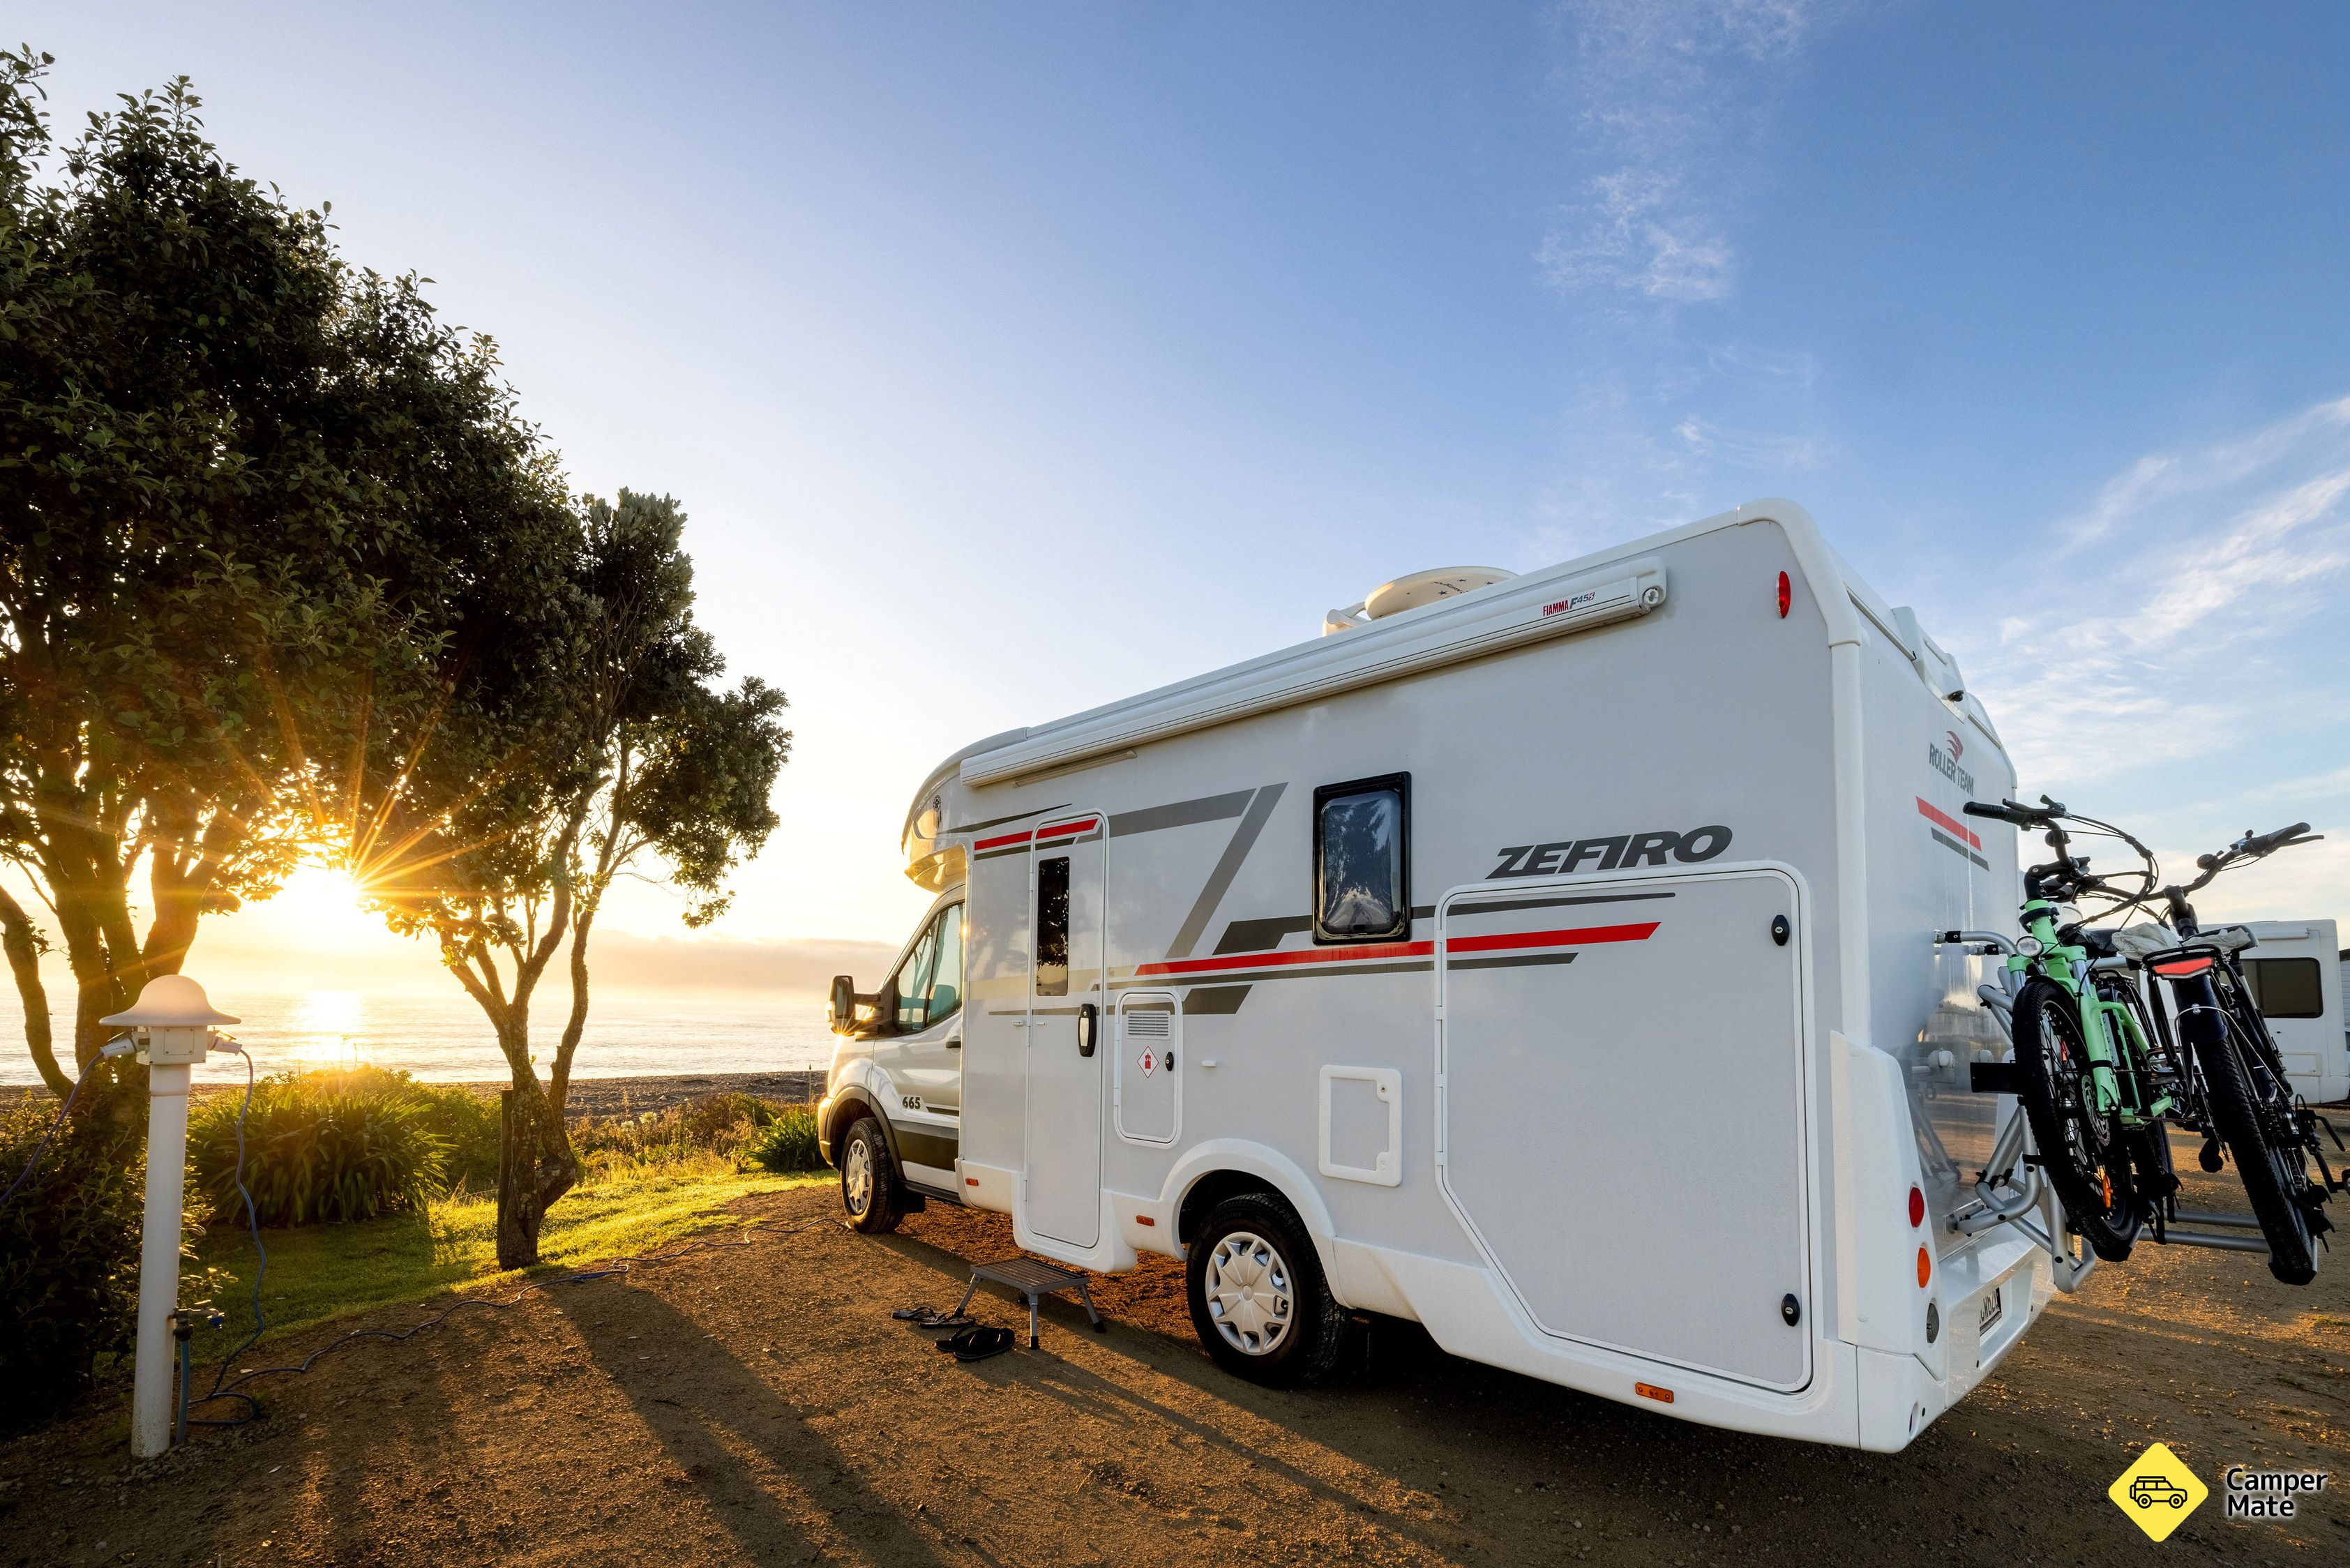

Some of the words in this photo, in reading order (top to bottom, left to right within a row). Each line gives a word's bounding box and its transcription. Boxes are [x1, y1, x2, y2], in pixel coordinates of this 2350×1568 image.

[1543, 600, 1569, 617] FIAMMA
[1929, 742, 1957, 783] ROLLER
[1957, 766, 1974, 797] TEAM
[1485, 825, 1733, 880] ZEFIRO
[902, 1096, 921, 1109] 665
